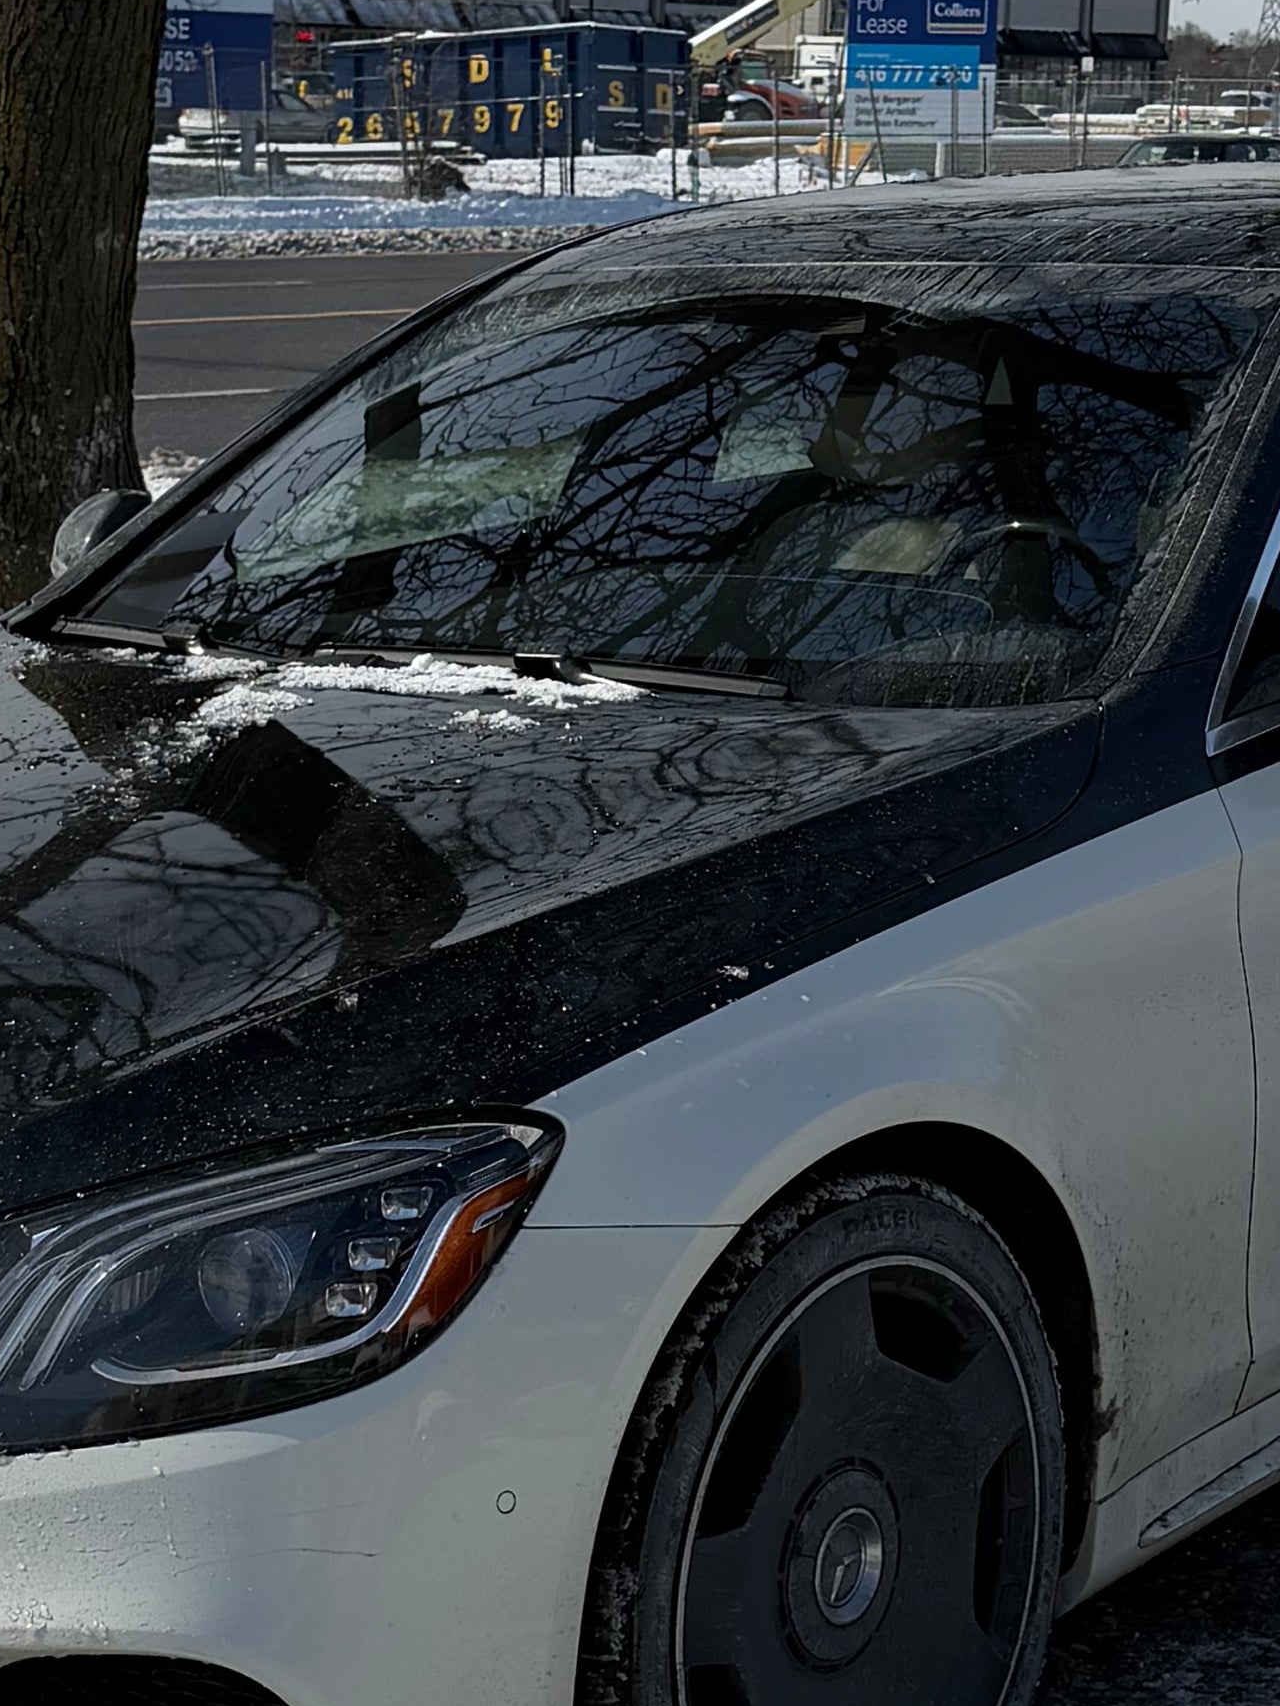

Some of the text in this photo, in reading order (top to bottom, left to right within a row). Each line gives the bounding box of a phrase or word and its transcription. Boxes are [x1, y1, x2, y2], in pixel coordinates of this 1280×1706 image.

[934, 3, 981, 18] Colliers
[163, 17, 190, 39] SE
[856, 14, 908, 34] Lease
[890, 65, 925, 83] 777
